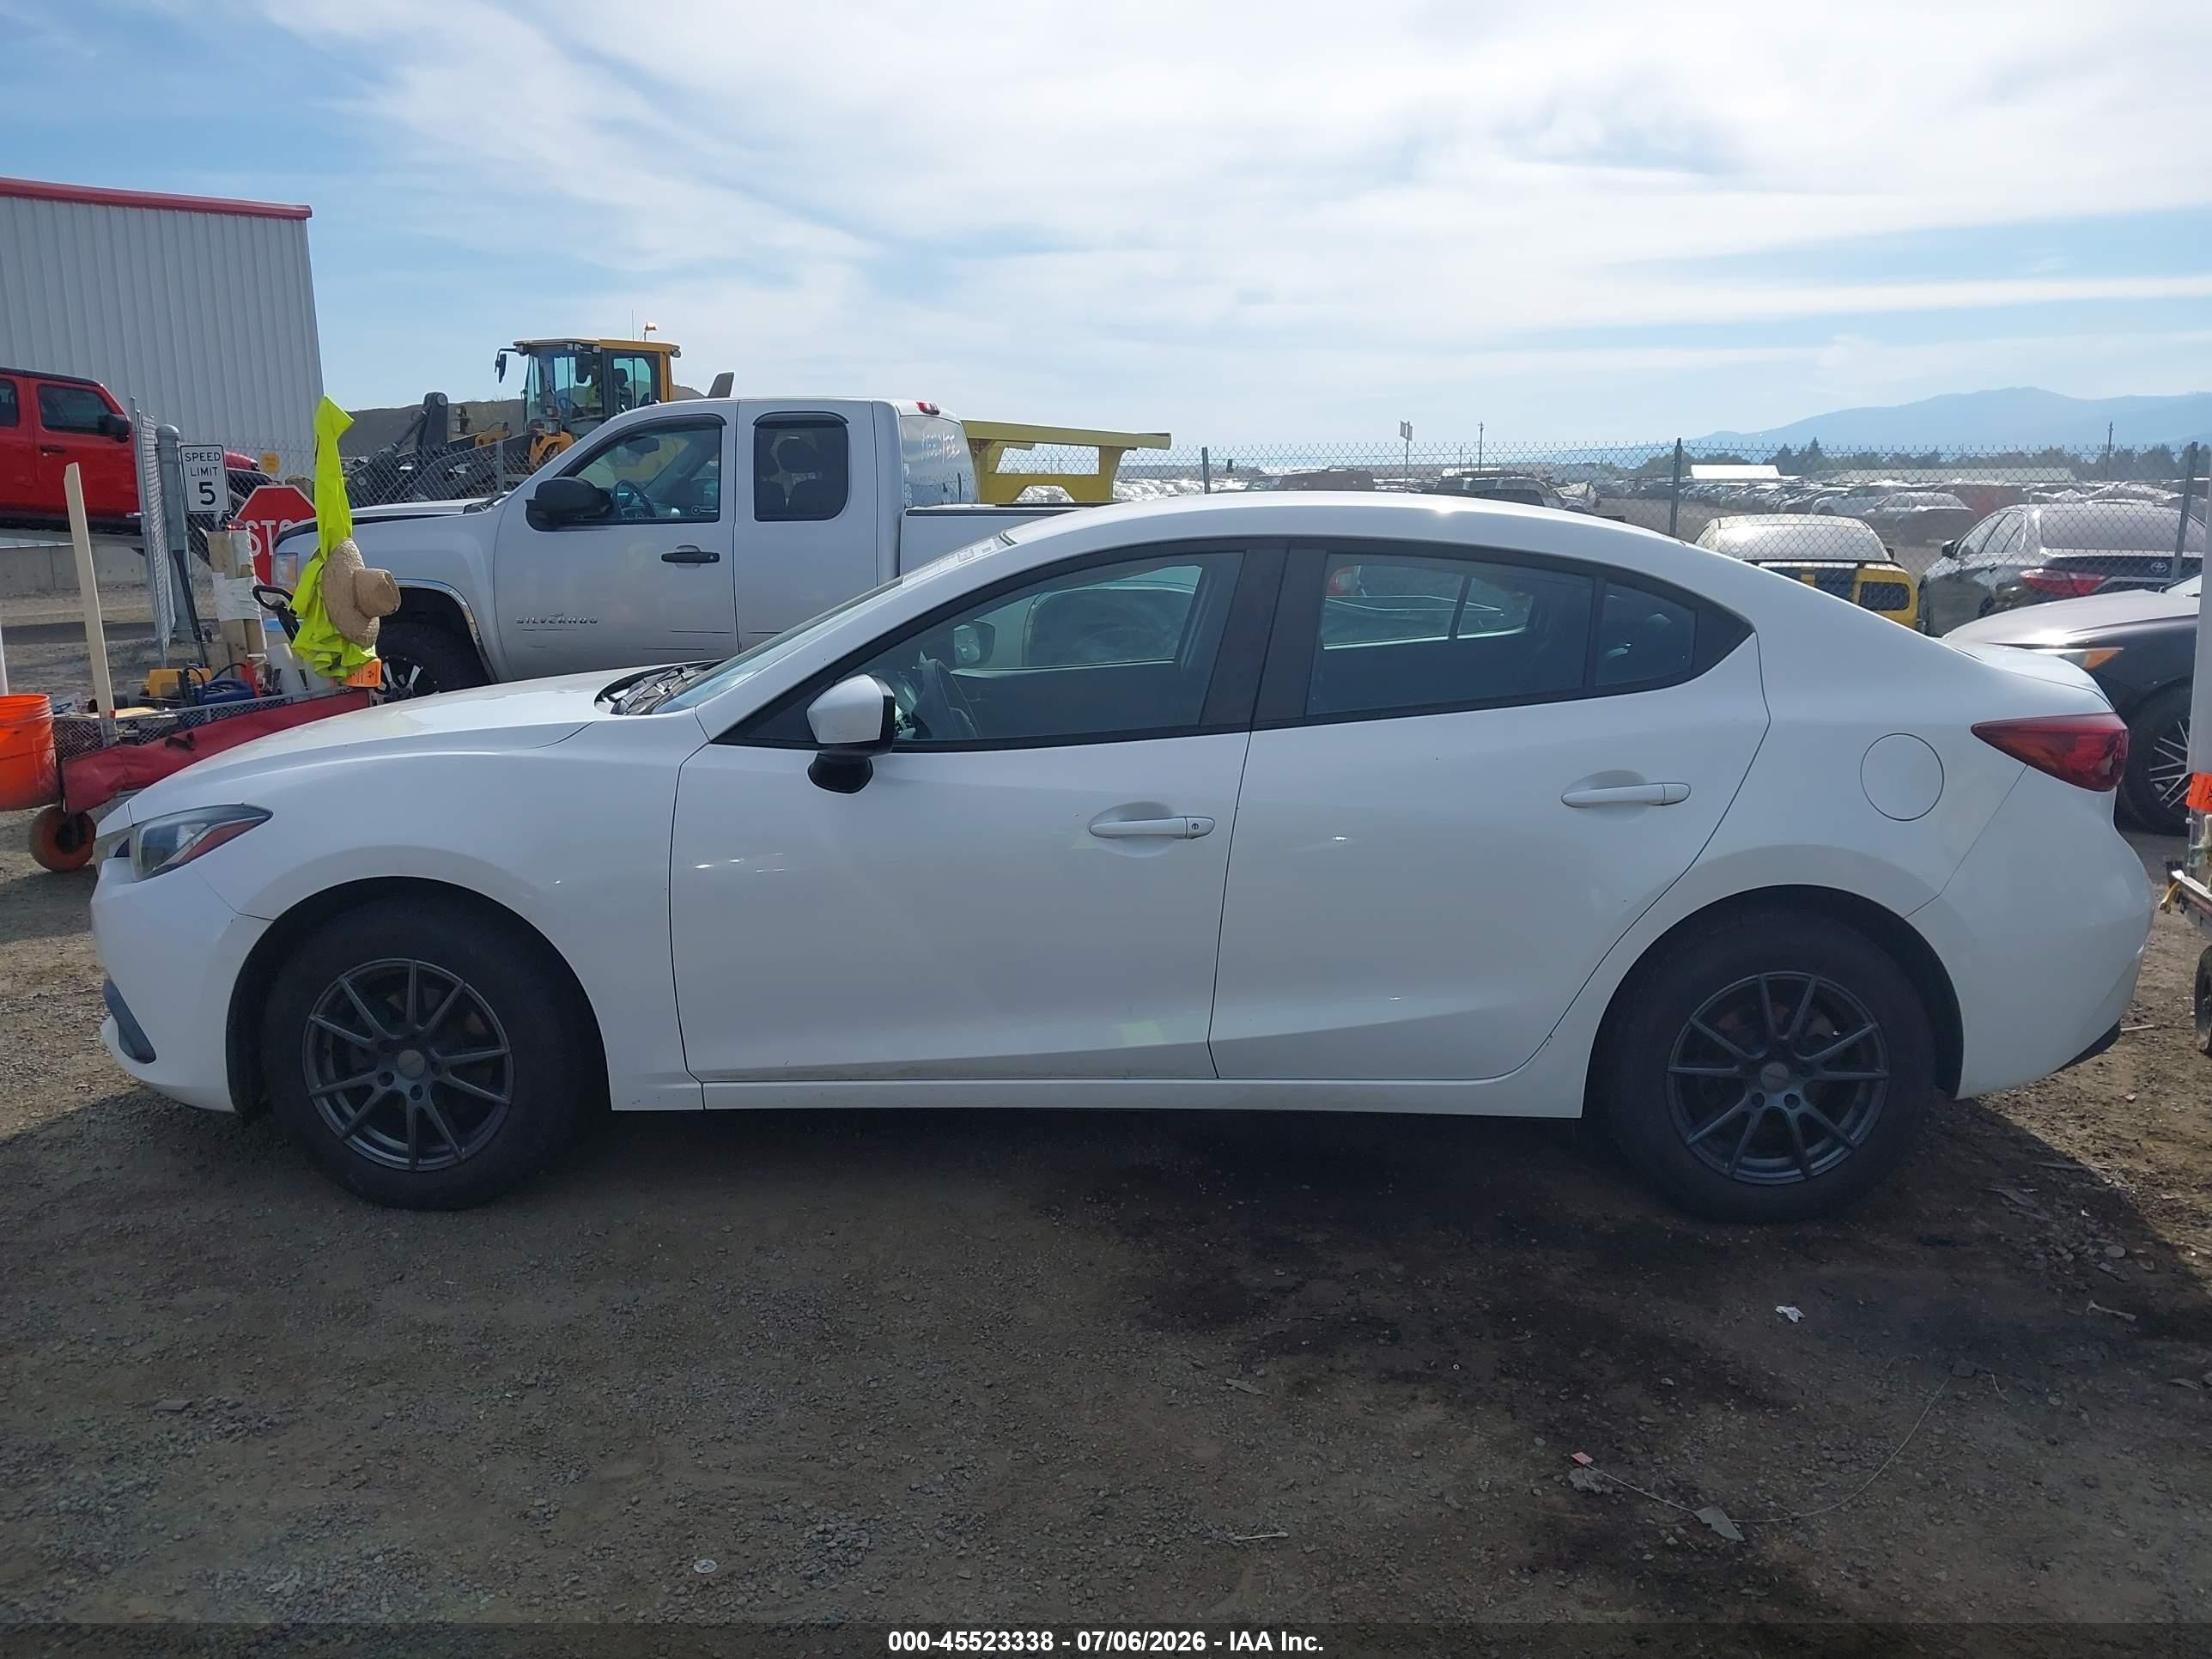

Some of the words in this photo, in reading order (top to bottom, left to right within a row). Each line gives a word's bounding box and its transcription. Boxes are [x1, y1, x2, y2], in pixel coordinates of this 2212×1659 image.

[185, 452, 221, 462] SPEED
[190, 466, 218, 477] LIMIT
[198, 481, 216, 506] 5
[245, 519, 294, 557] ST
